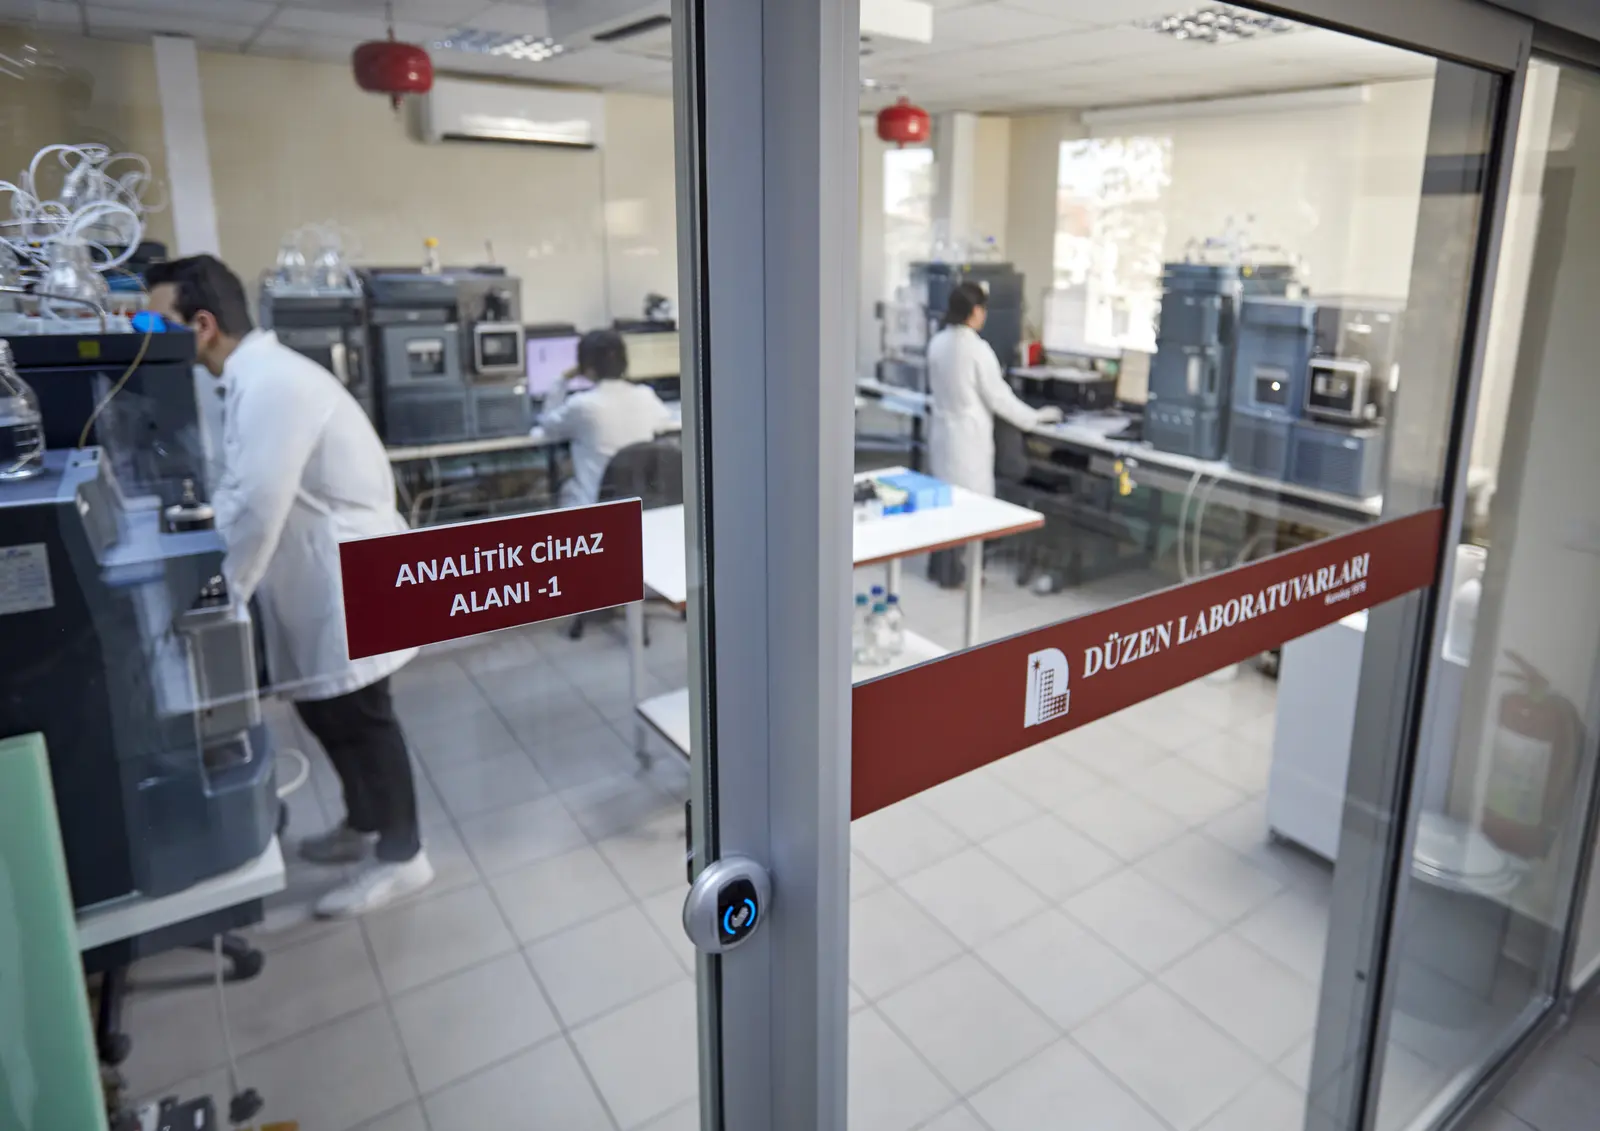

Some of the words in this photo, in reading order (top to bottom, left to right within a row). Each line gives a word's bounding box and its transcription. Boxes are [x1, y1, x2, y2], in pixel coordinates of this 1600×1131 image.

[395, 542, 524, 588] ANALİTİK
[530, 532, 604, 564] CİHAZ
[449, 581, 530, 617] ALANI
[537, 575, 562, 598] -1
[1082, 621, 1174, 679] DÜZEN
[1177, 552, 1371, 645] LABORATUVARLARI
